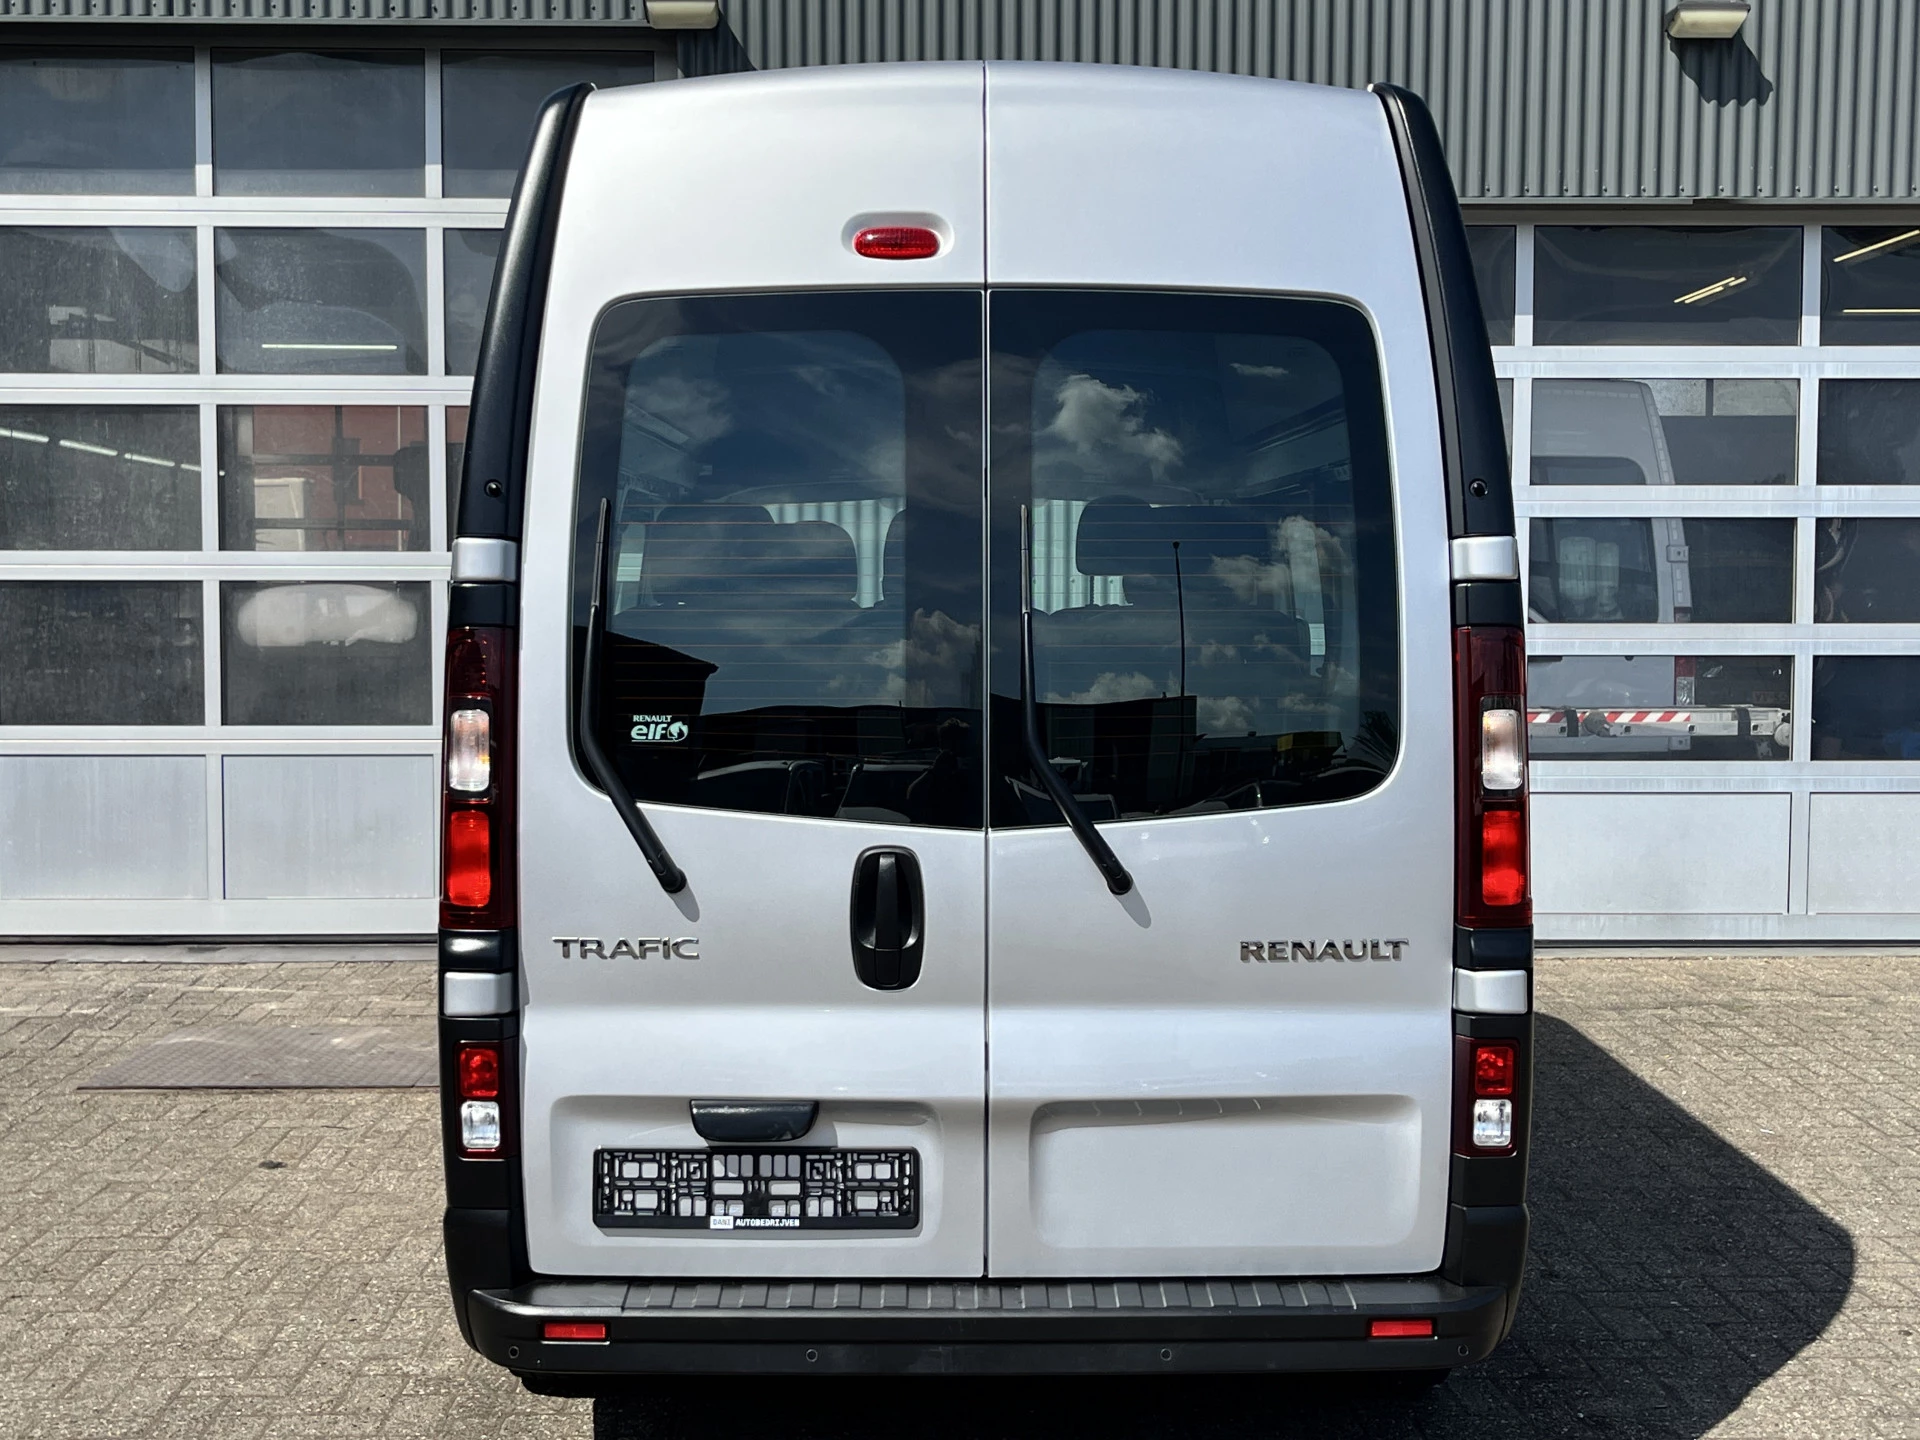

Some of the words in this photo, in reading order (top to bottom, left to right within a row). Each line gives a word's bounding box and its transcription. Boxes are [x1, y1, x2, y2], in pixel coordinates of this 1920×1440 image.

[633, 714, 673, 723] RENAULT
[630, 723, 668, 740] elf
[552, 936, 700, 959] TRAFIC
[1240, 938, 1410, 961] RENAULT
[735, 1218, 801, 1227] AUTOBEDRIJVEN
